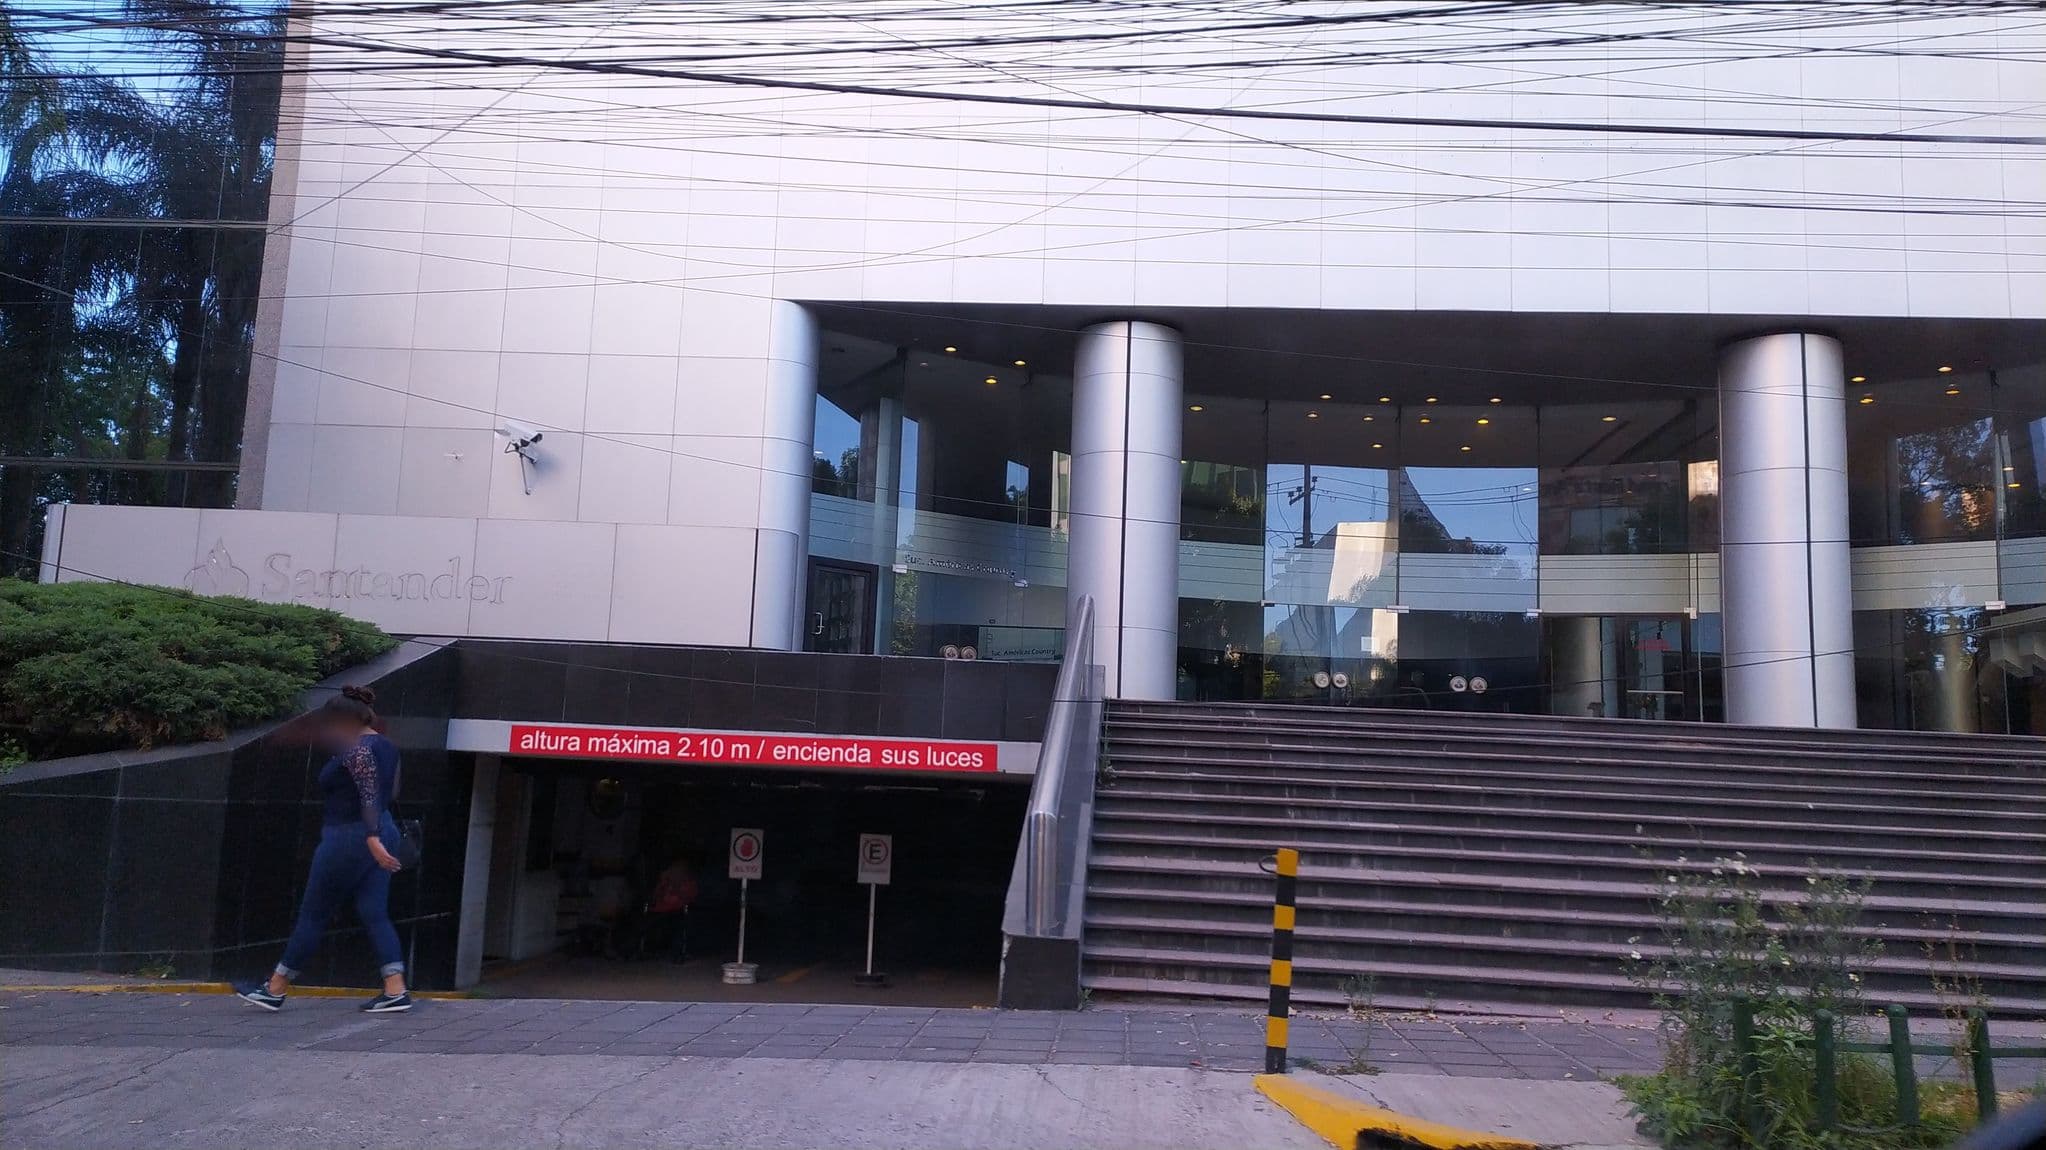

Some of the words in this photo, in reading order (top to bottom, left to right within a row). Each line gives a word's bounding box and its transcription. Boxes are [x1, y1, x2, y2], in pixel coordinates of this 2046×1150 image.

[262, 553, 512, 603] Santander
[520, 730, 580, 751] altura
[587, 733, 670, 755] máxima
[677, 737, 724, 758] 2.10
[731, 743, 750, 759] m
[756, 739, 766, 760] /
[773, 742, 871, 763] encienda
[881, 748, 920, 765] sus
[926, 746, 983, 768] luces
[869, 843, 881, 860] E
